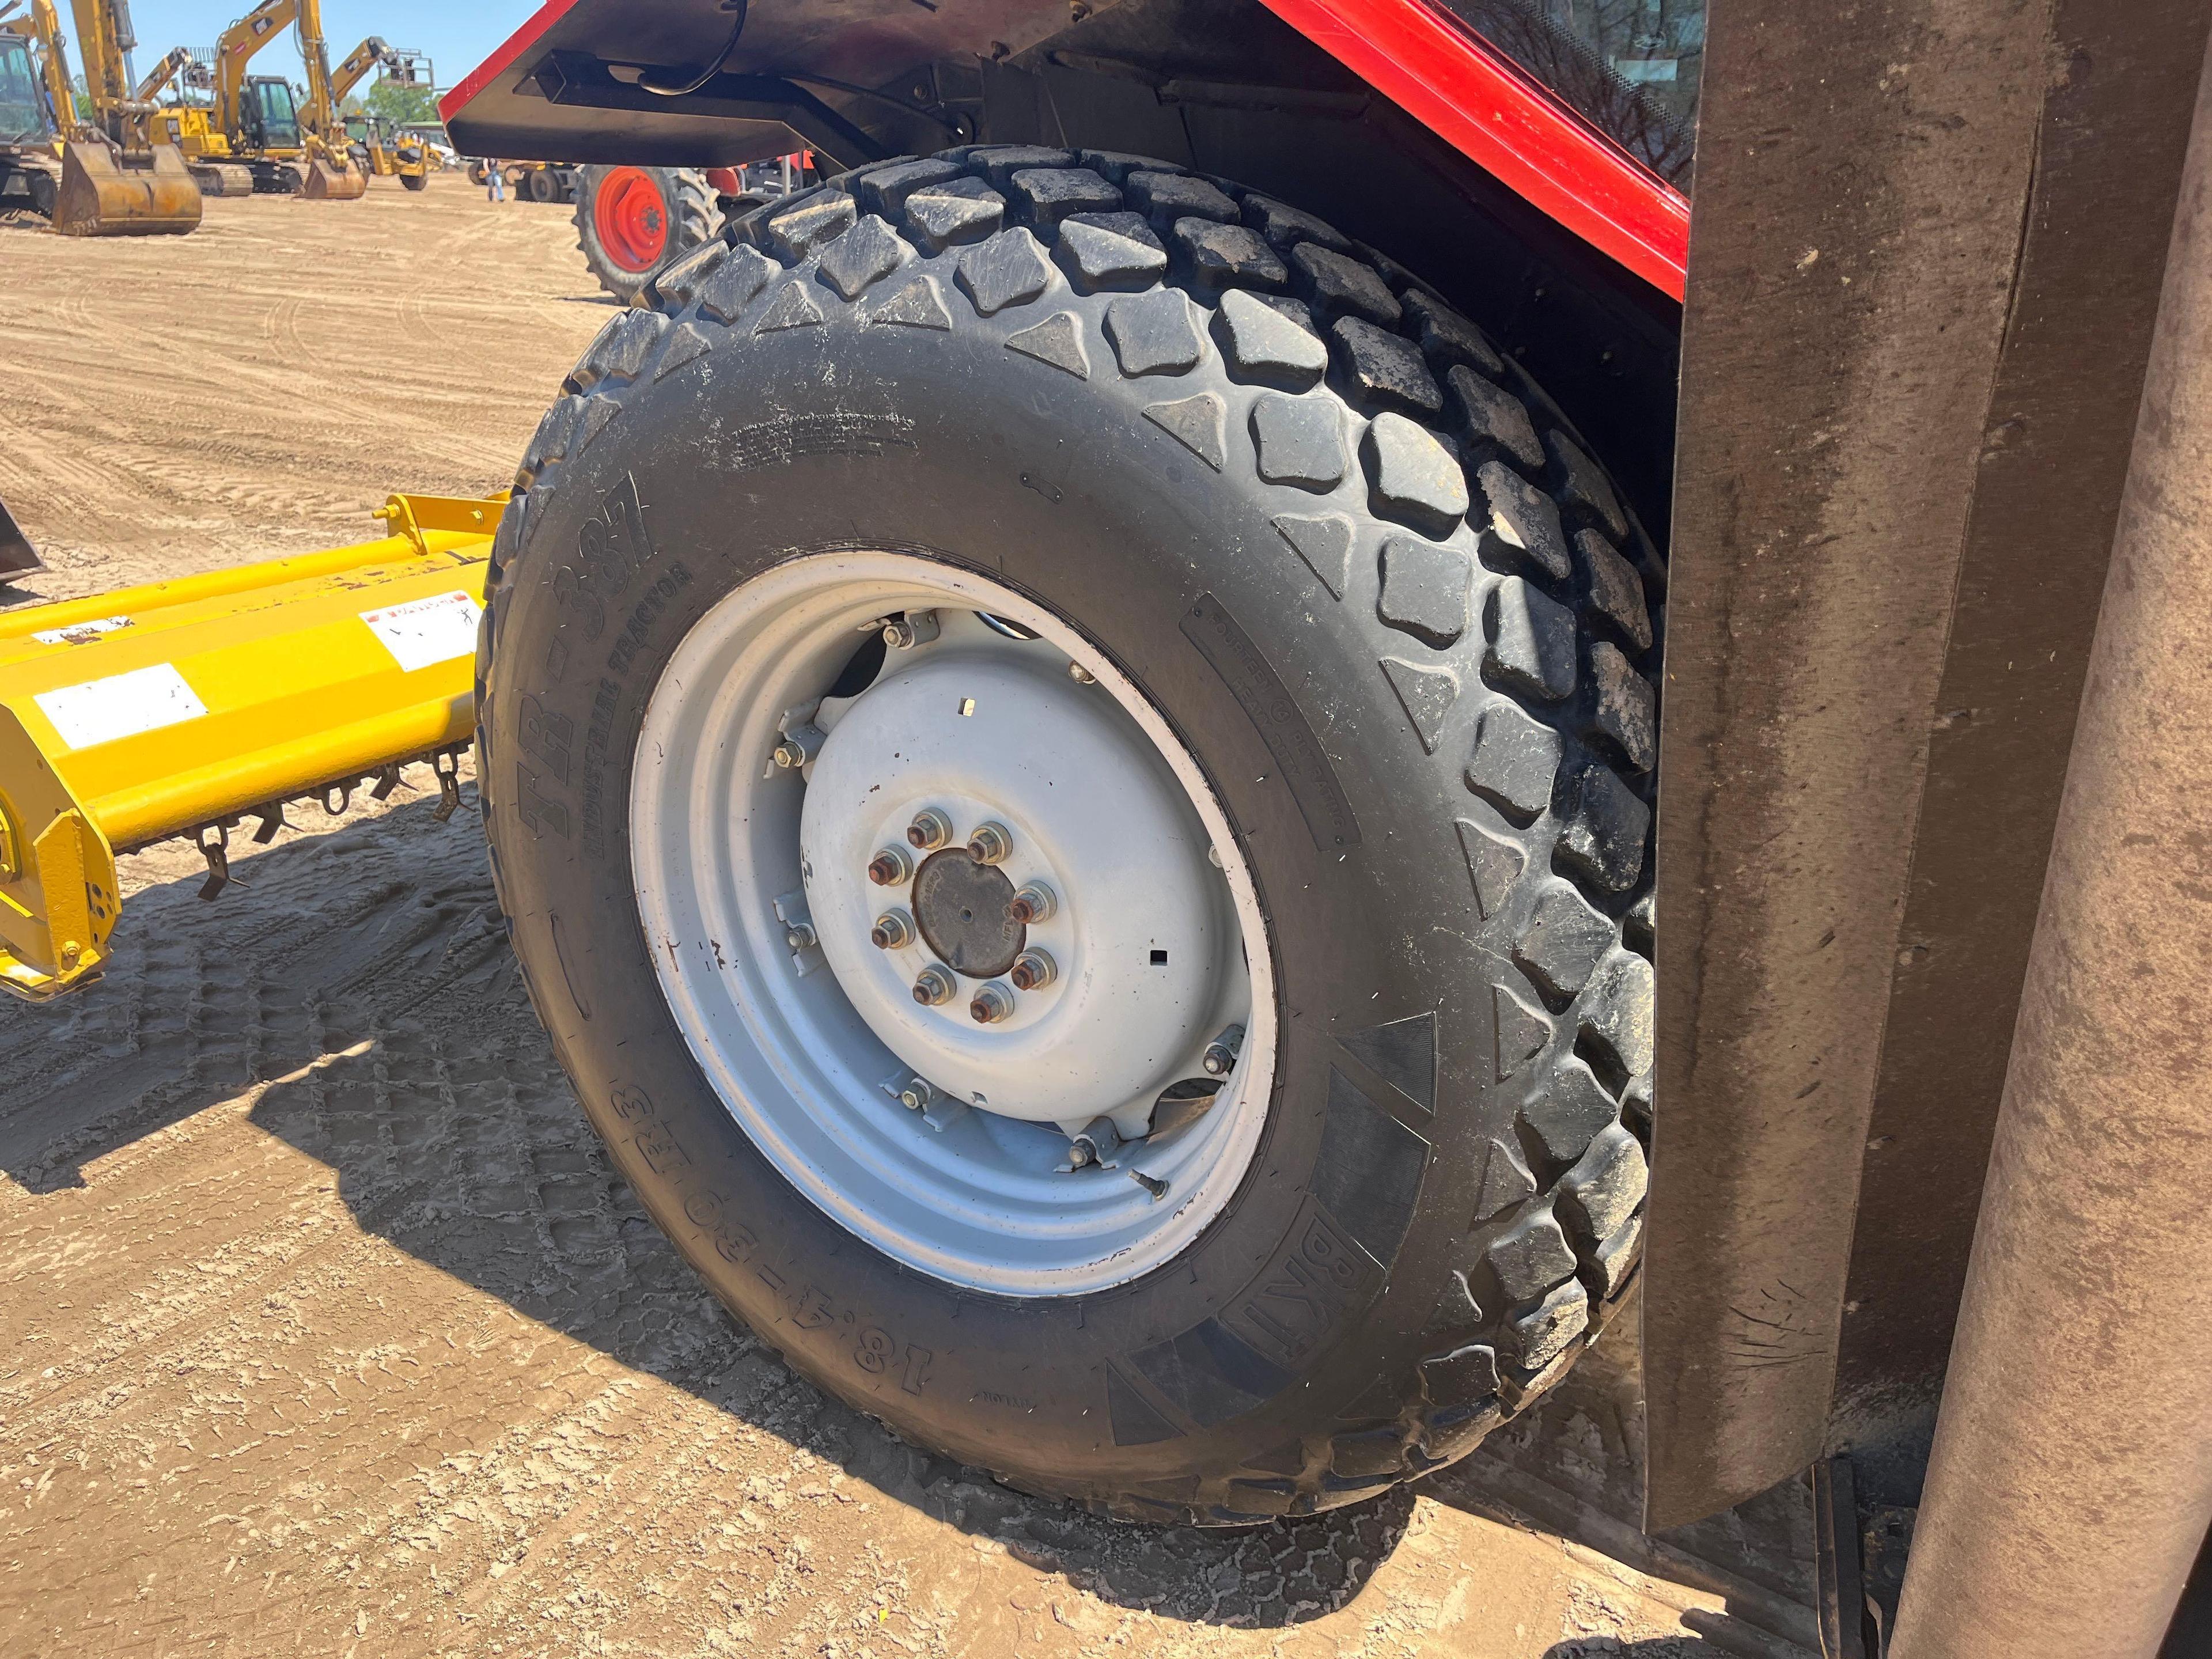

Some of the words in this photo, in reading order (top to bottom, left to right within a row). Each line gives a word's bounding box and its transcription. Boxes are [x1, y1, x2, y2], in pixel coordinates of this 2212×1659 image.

[581, 677, 623, 860] INDUSTRIAL
[607, 562, 692, 677] TRACTOR
[1209, 614, 1274, 693] FOURTEEN
[1272, 702, 1291, 722] 14
[1291, 729, 1316, 762] PLY
[1309, 766, 1347, 829] RATING
[1232, 676, 1273, 730] HEAVY
[1270, 733, 1302, 779] DUTY
[1242, 1212, 1371, 1361] BKT
